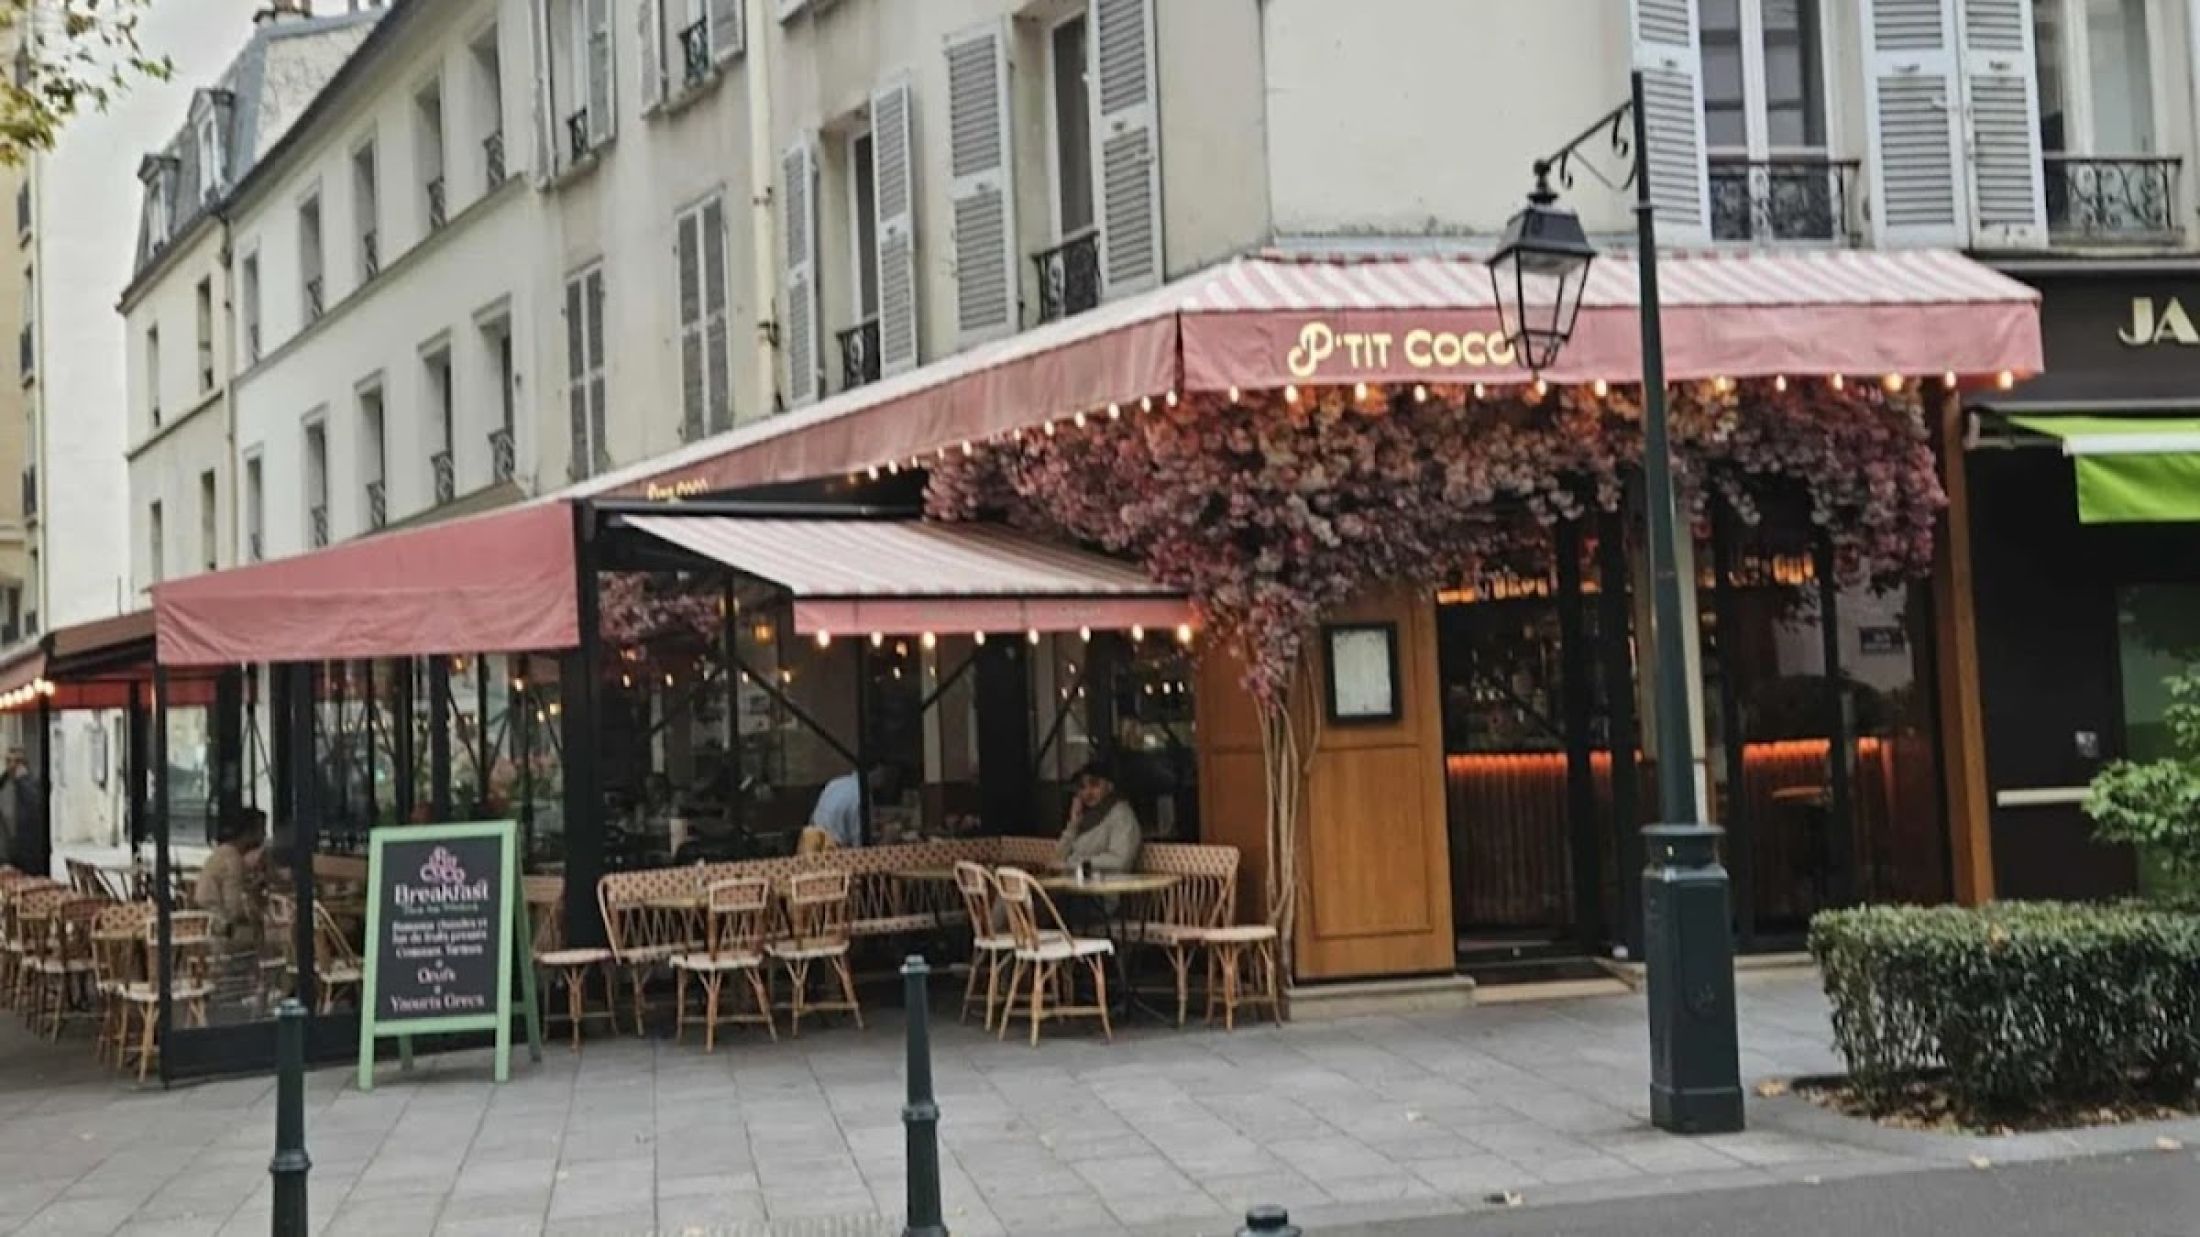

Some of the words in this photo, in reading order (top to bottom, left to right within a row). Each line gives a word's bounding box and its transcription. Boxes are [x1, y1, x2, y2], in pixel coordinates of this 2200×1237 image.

[2117, 296, 2200, 346] JA
[1287, 320, 1392, 377] P'TIT
[394, 879, 489, 905] Breakfast
